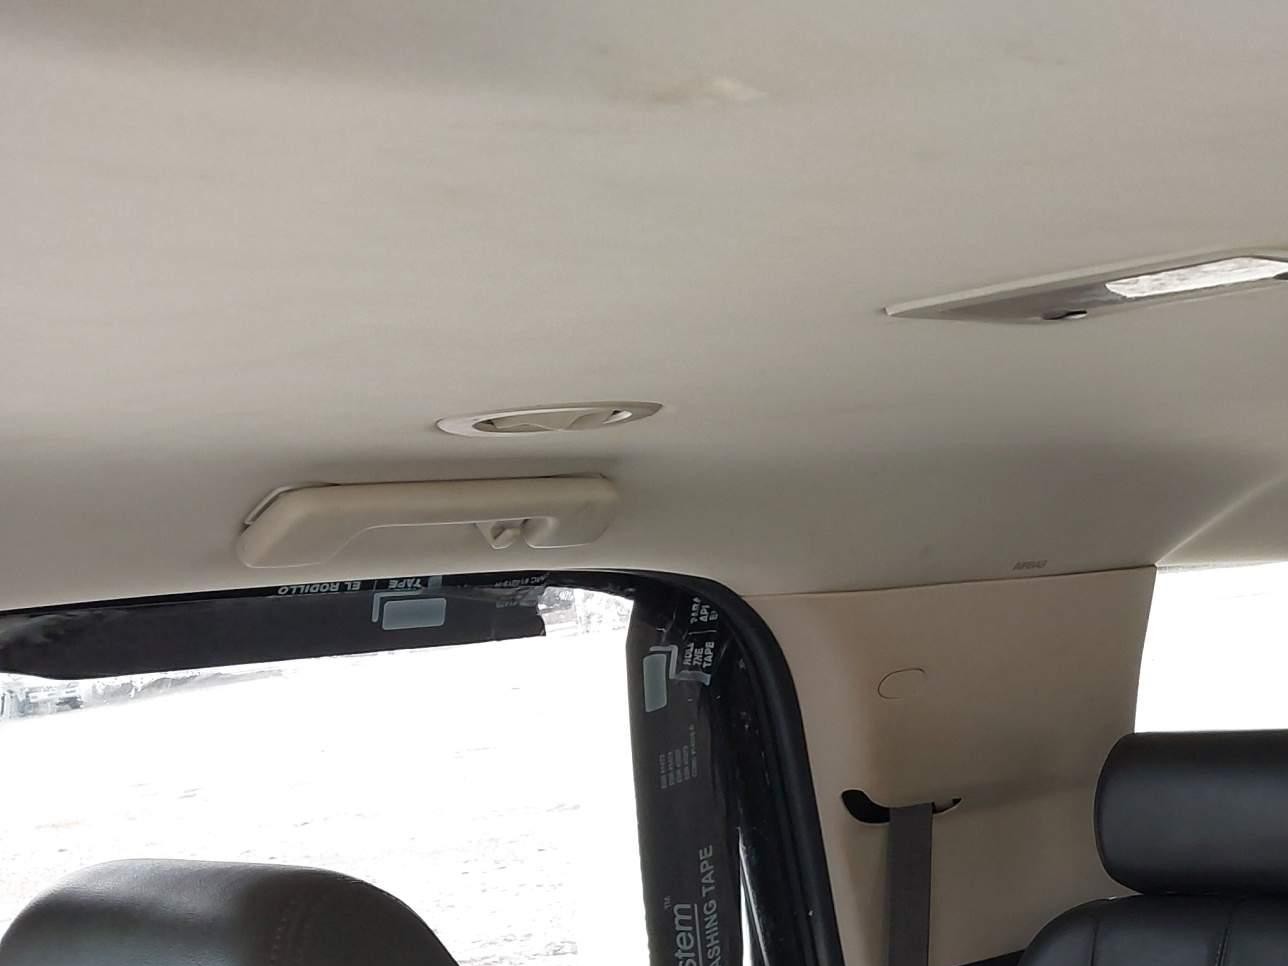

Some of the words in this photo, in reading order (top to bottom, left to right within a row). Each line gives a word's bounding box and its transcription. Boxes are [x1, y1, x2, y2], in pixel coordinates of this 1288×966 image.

[278, 582, 339, 595] RODILLO
[345, 581, 361, 591] EL
[388, 578, 421, 589] TAPE
[703, 641, 715, 668] TAPE
[700, 845, 716, 897] TAPE
